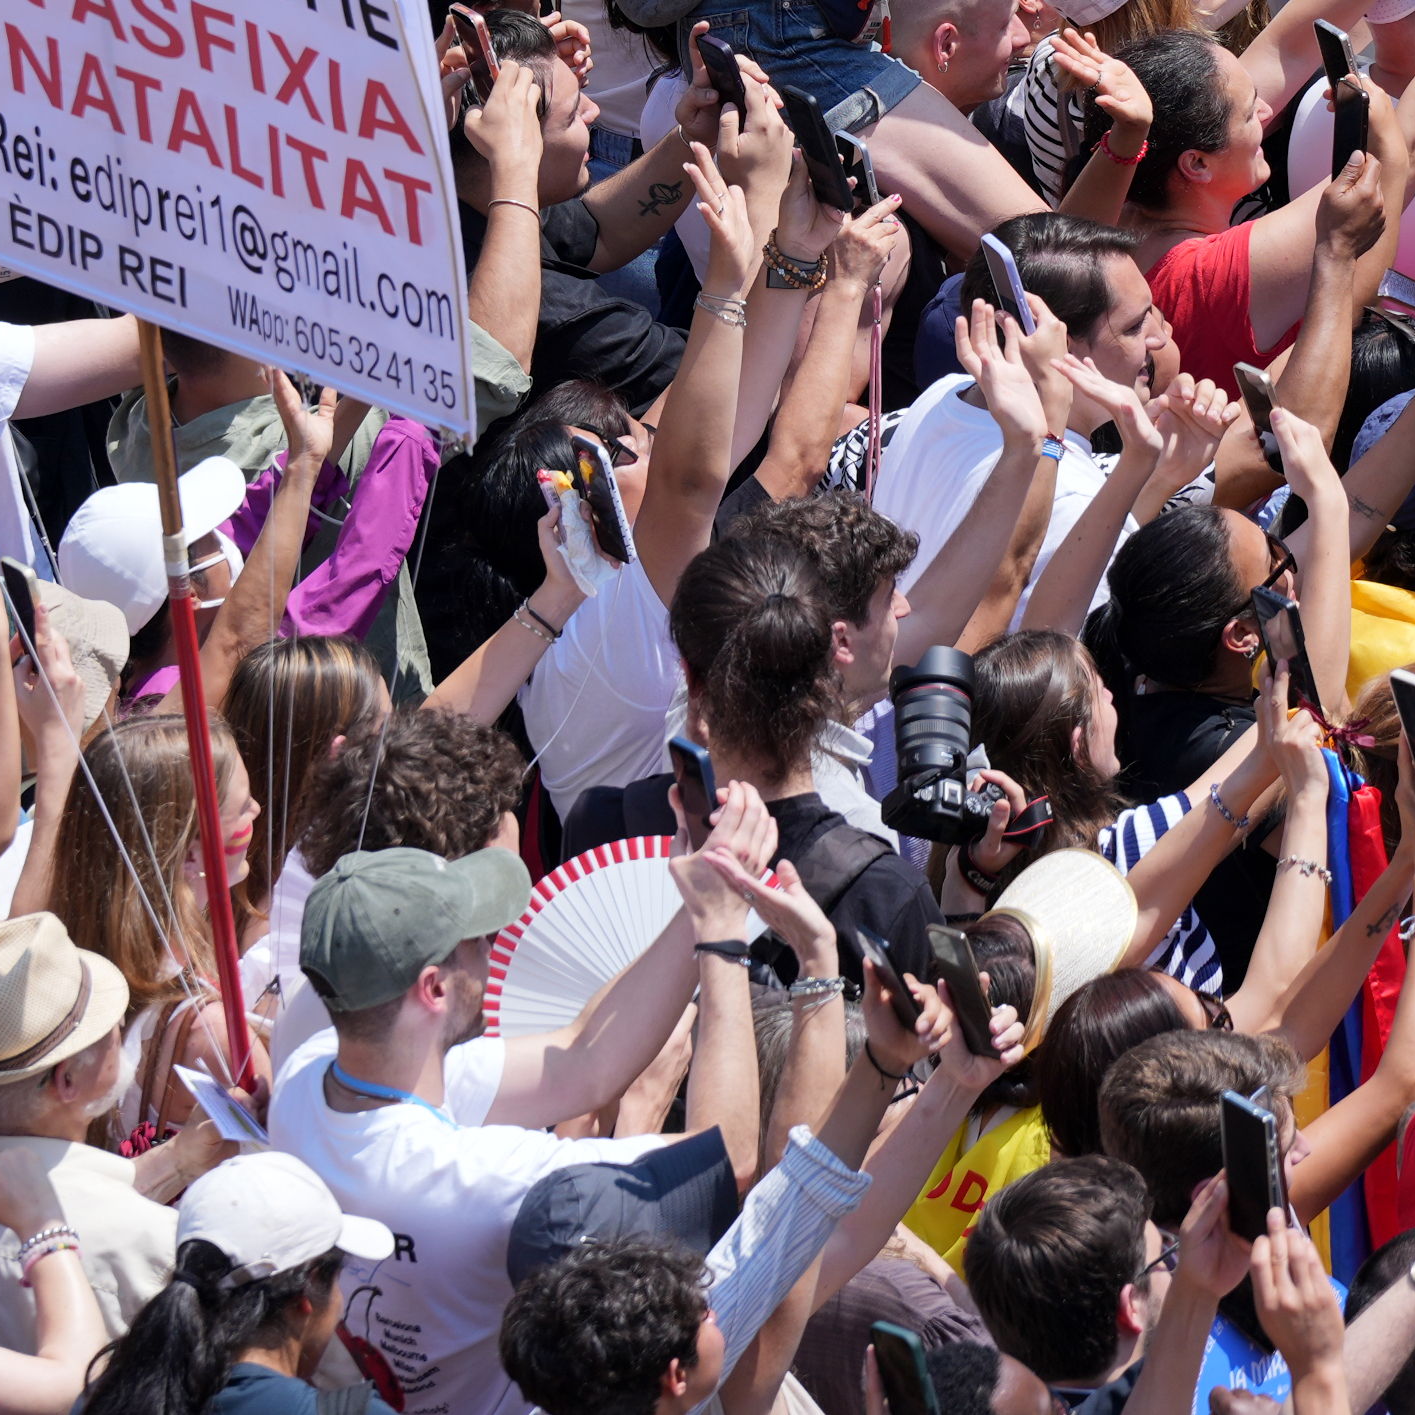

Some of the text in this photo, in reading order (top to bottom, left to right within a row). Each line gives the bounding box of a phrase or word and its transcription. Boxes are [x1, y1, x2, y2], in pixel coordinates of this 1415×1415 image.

[5, 22, 432, 246] NATALITAT
[9, 193, 104, 271] ÈDIP
[118, 245, 188, 309] REI
[70, 155, 455, 341] ediprei1@gmail.com
[380, 1338, 428, 1362] Melbourne
